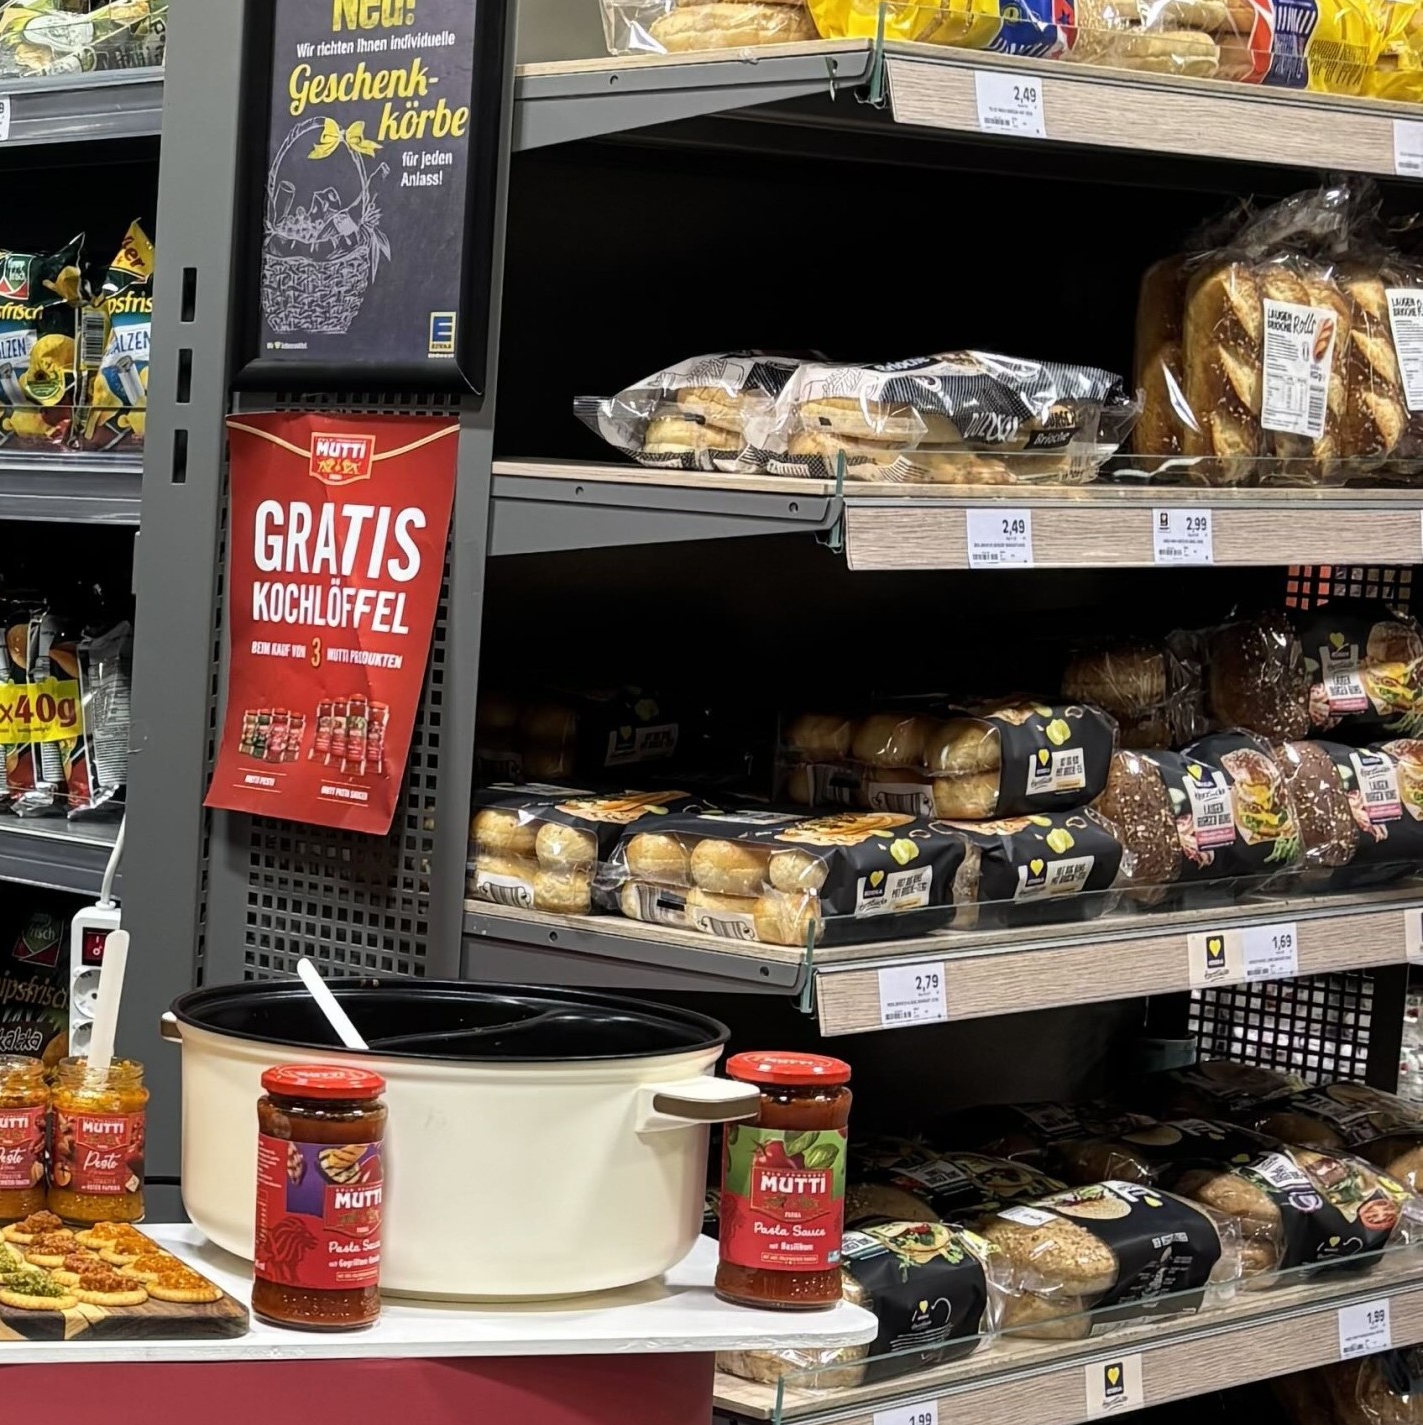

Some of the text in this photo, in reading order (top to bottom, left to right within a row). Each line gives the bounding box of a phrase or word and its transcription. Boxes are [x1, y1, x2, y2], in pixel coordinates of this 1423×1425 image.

[297, 31, 456, 58] Wir richten Ihnen individuelle
[289, 58, 439, 117] Geschenk-
[1014, 85, 1037, 104] 2,49
[378, 97, 470, 143] körbe
[402, 151, 453, 169] für jeden
[400, 171, 444, 188] Anlass!
[108, 291, 153, 315] psfris
[316, 441, 367, 460] MUTTI
[1002, 518, 1026, 537] 2,49
[1186, 516, 1207, 533] 2,99
[253, 499, 427, 583] GRATIS
[252, 579, 410, 635] KOCHLÖFFEL
[251, 641, 271, 656] BEIM
[271, 643, 291, 658] KAUF
[311, 637, 322, 667] 3
[327, 647, 349, 663] MUTTI
[350, 649, 403, 669] PRODUKTEN
[1272, 934, 1292, 950] 1,69
[915, 973, 940, 993] 2,79
[82, 1120, 124, 1135] MUTTI
[83, 1150, 122, 1171] Pesto
[760, 1174, 827, 1194] MUTTI
[753, 1221, 827, 1237] Pasta Sauce
[328, 1237, 381, 1254] Pasta Sau
[1367, 1309, 1385, 1326] 1,99
